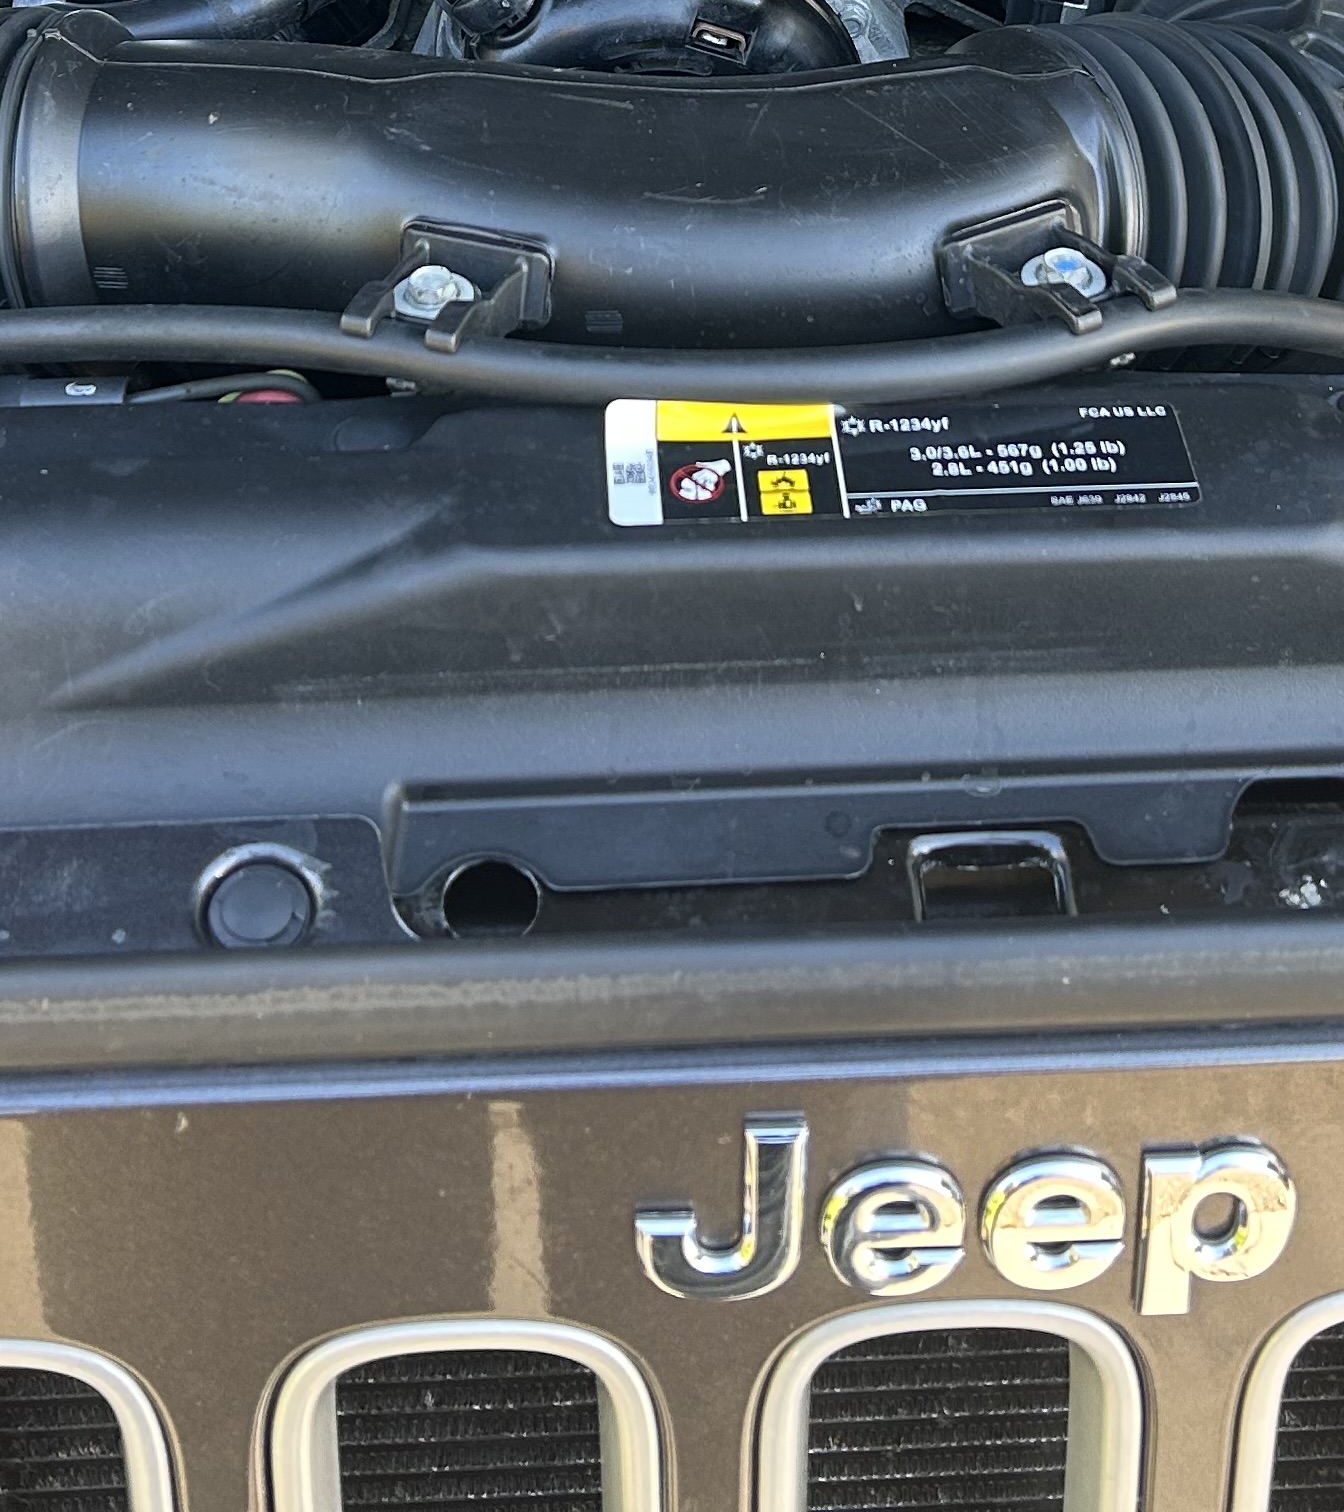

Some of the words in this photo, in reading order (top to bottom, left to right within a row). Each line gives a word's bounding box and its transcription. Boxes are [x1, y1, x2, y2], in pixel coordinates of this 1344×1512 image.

[1078, 406, 1111, 419] FCA
[1112, 405, 1135, 418] US
[1136, 404, 1167, 417] LLC
[868, 416, 949, 434] R-1234yf
[766, 451, 831, 466] R-1234yf
[1041, 457, 1088, 475] (1.00
[1090, 456, 1117, 474] lb)
[890, 498, 928, 513] PAG
[633, 1109, 1297, 1317] Jeep
